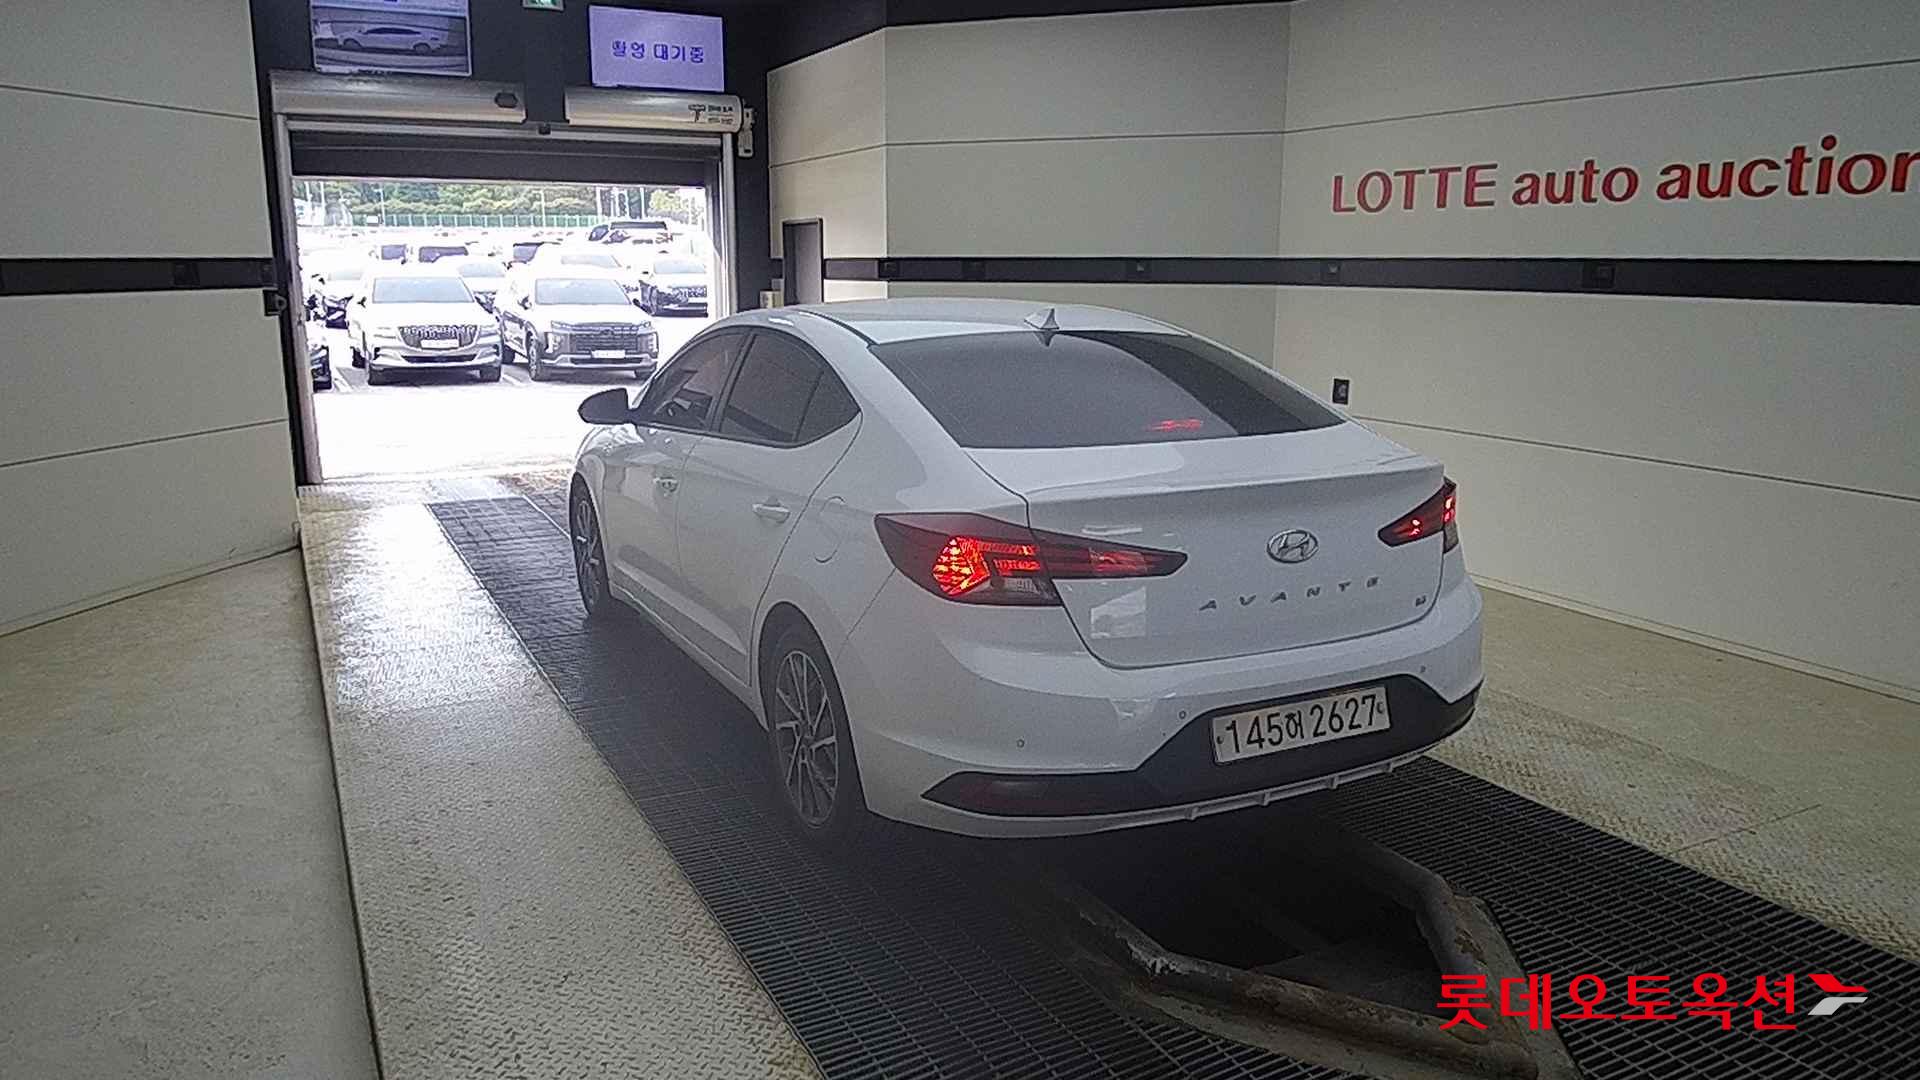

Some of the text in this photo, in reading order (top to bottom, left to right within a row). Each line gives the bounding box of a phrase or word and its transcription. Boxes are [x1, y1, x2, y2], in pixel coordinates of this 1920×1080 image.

[612, 39, 704, 63] 촬영 대기중
[1332, 163, 1498, 214] LOTTE
[1513, 159, 1639, 205] auto
[1199, 577, 1379, 611] AVANTE
